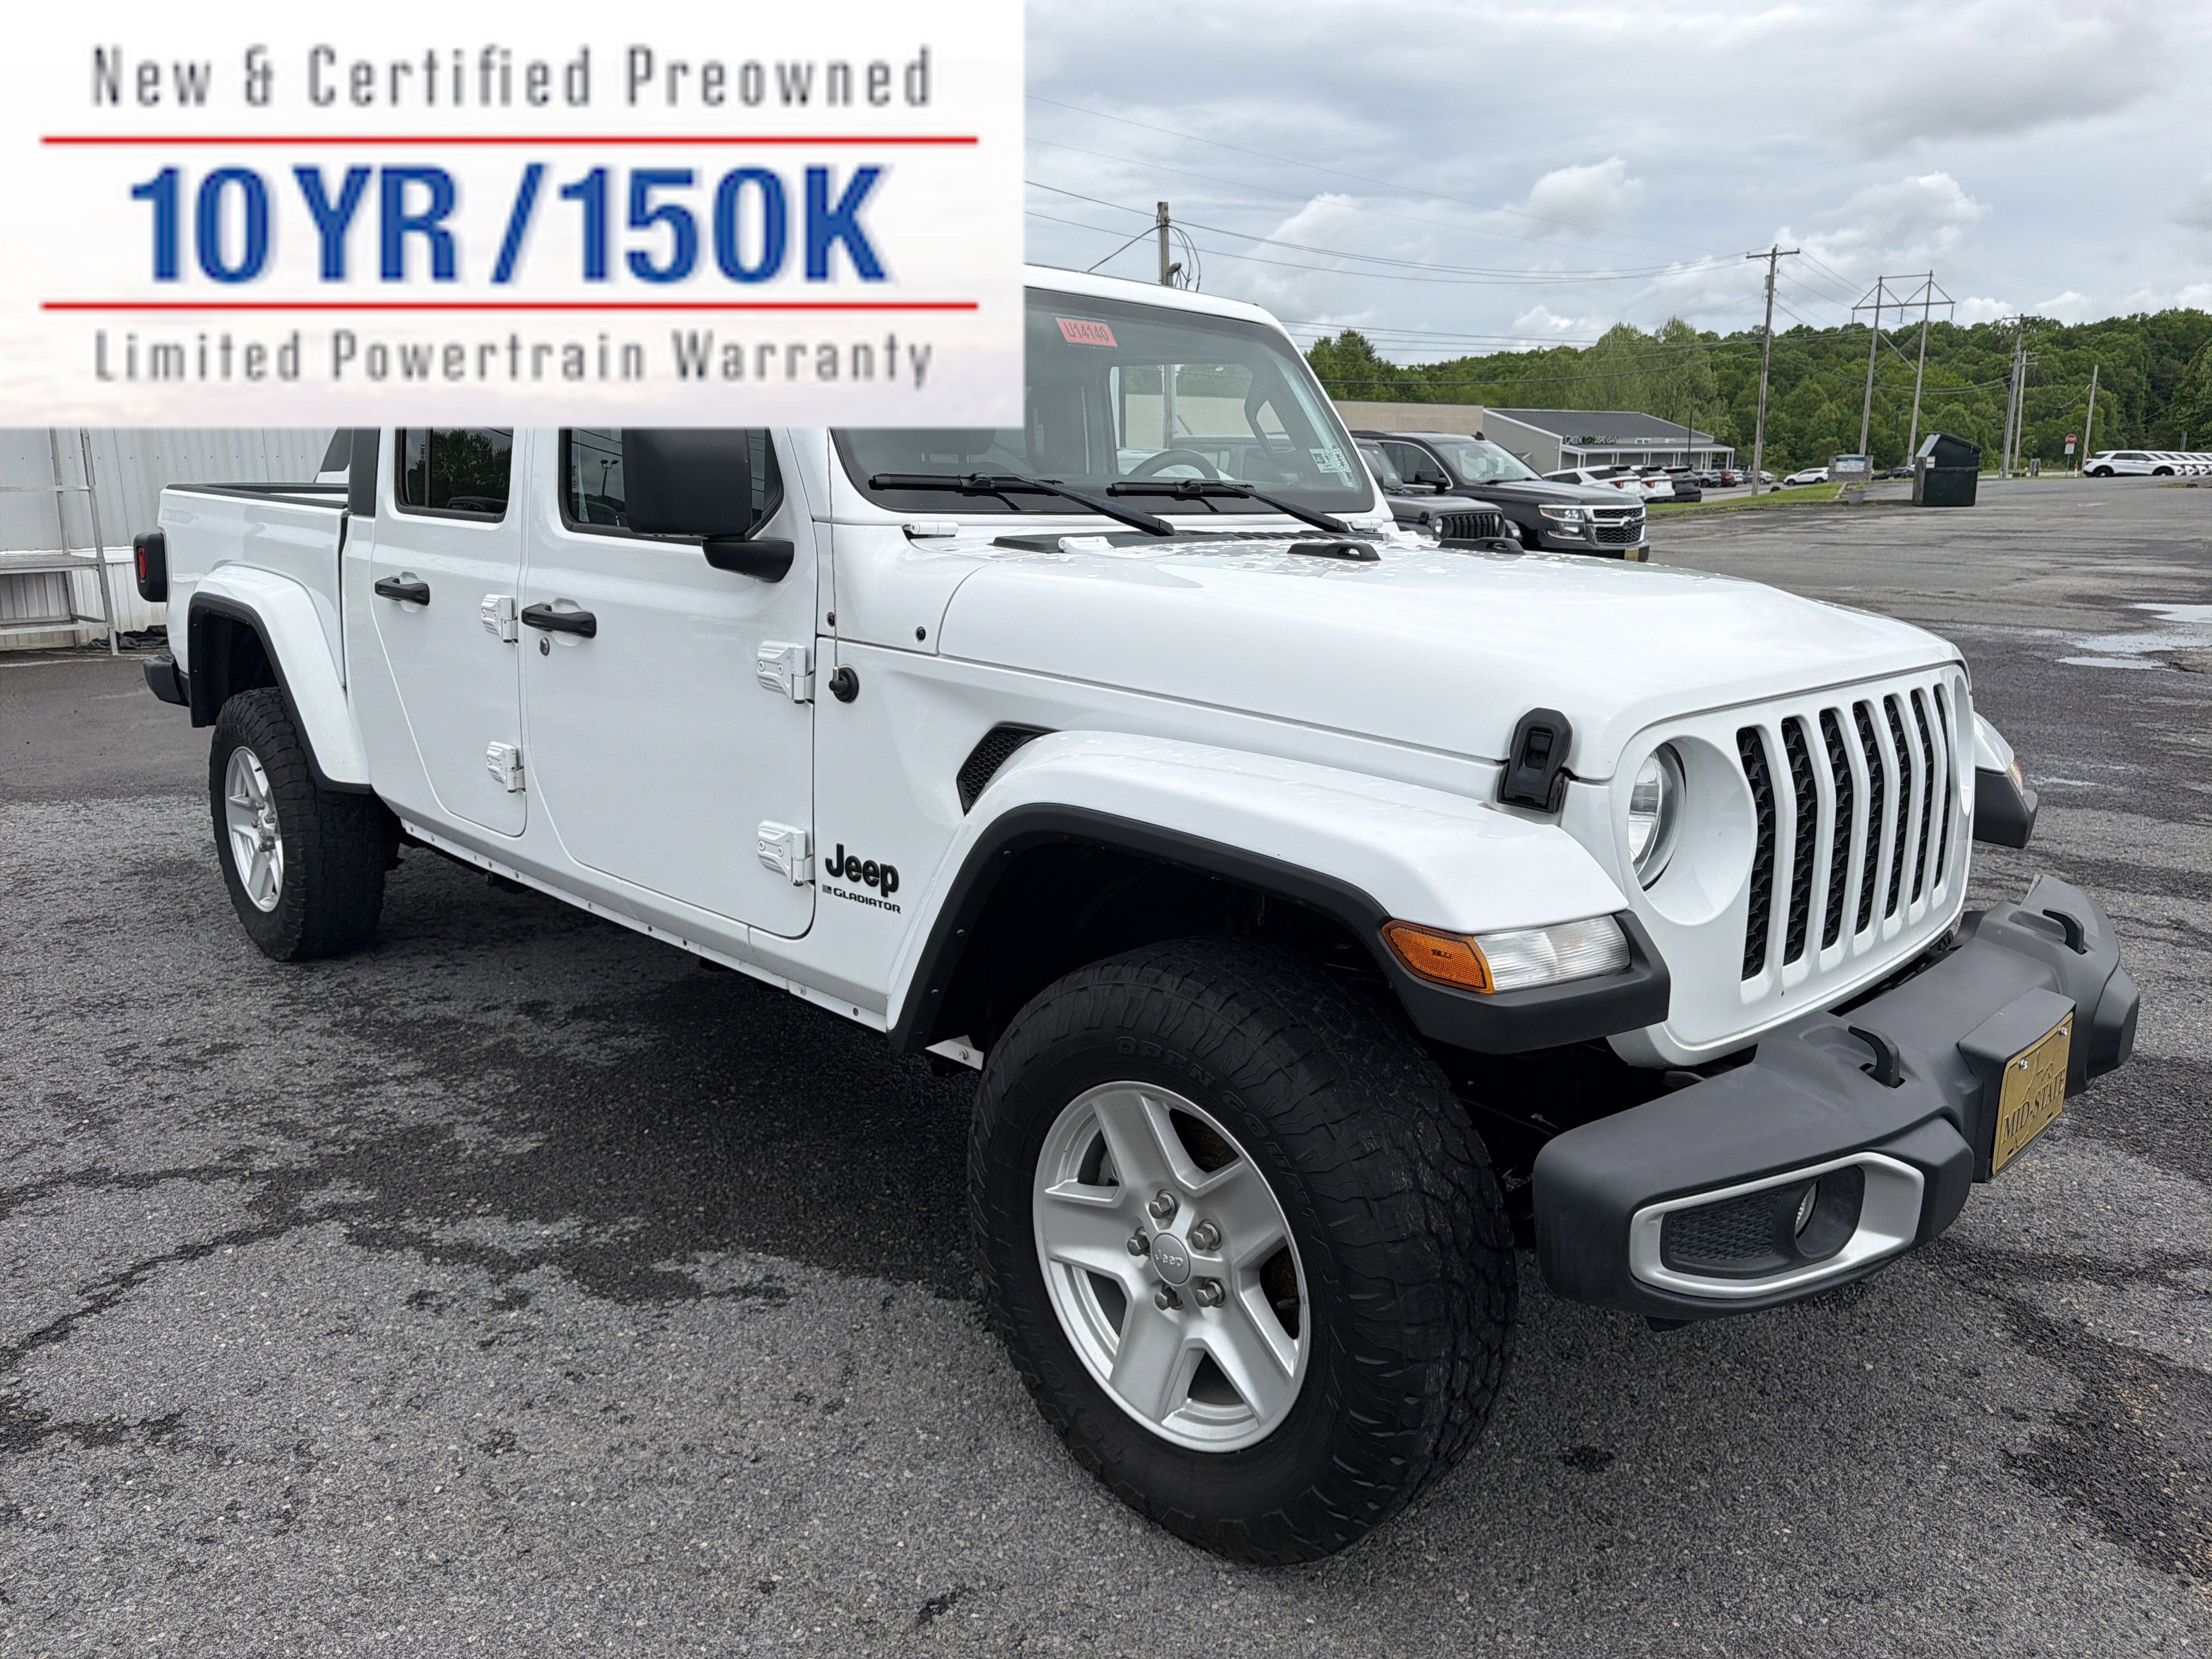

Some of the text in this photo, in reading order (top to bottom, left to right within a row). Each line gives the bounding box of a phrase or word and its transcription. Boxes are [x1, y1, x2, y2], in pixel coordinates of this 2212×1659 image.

[1064, 322, 1109, 341] U14140
[825, 843, 900, 898] Jeep
[833, 888, 901, 914] GLADIATOR
[2000, 1066, 2066, 1144] MID-STATE
[1154, 1249, 1184, 1267] Jeep
